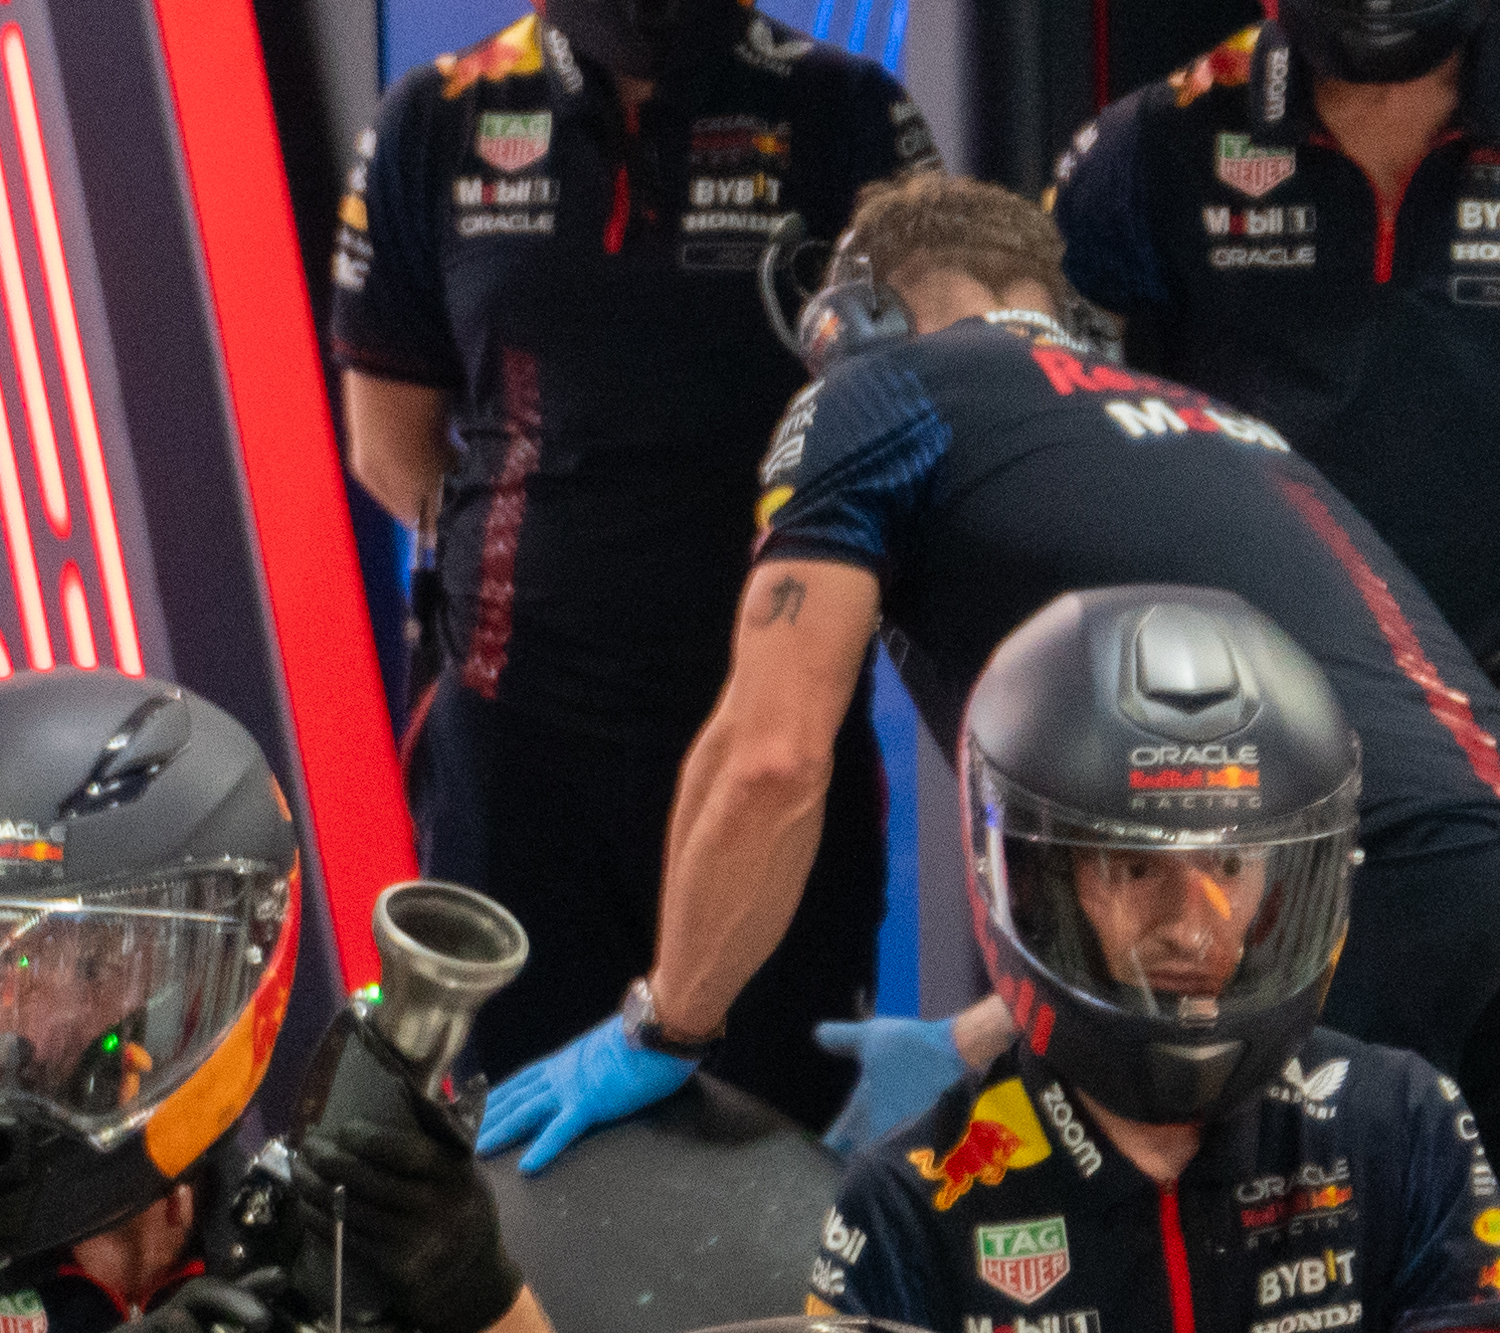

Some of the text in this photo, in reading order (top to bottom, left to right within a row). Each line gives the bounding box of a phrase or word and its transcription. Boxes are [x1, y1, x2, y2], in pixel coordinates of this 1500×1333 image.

[1210, 246, 1316, 268] ORACLE
[1129, 744, 1260, 767] ORACLE
[1041, 1090, 1102, 1178] zoom
[986, 1224, 1062, 1256] TAG
[984, 1249, 1068, 1297] HEUER
[1257, 1249, 1356, 1306] BYBIT
